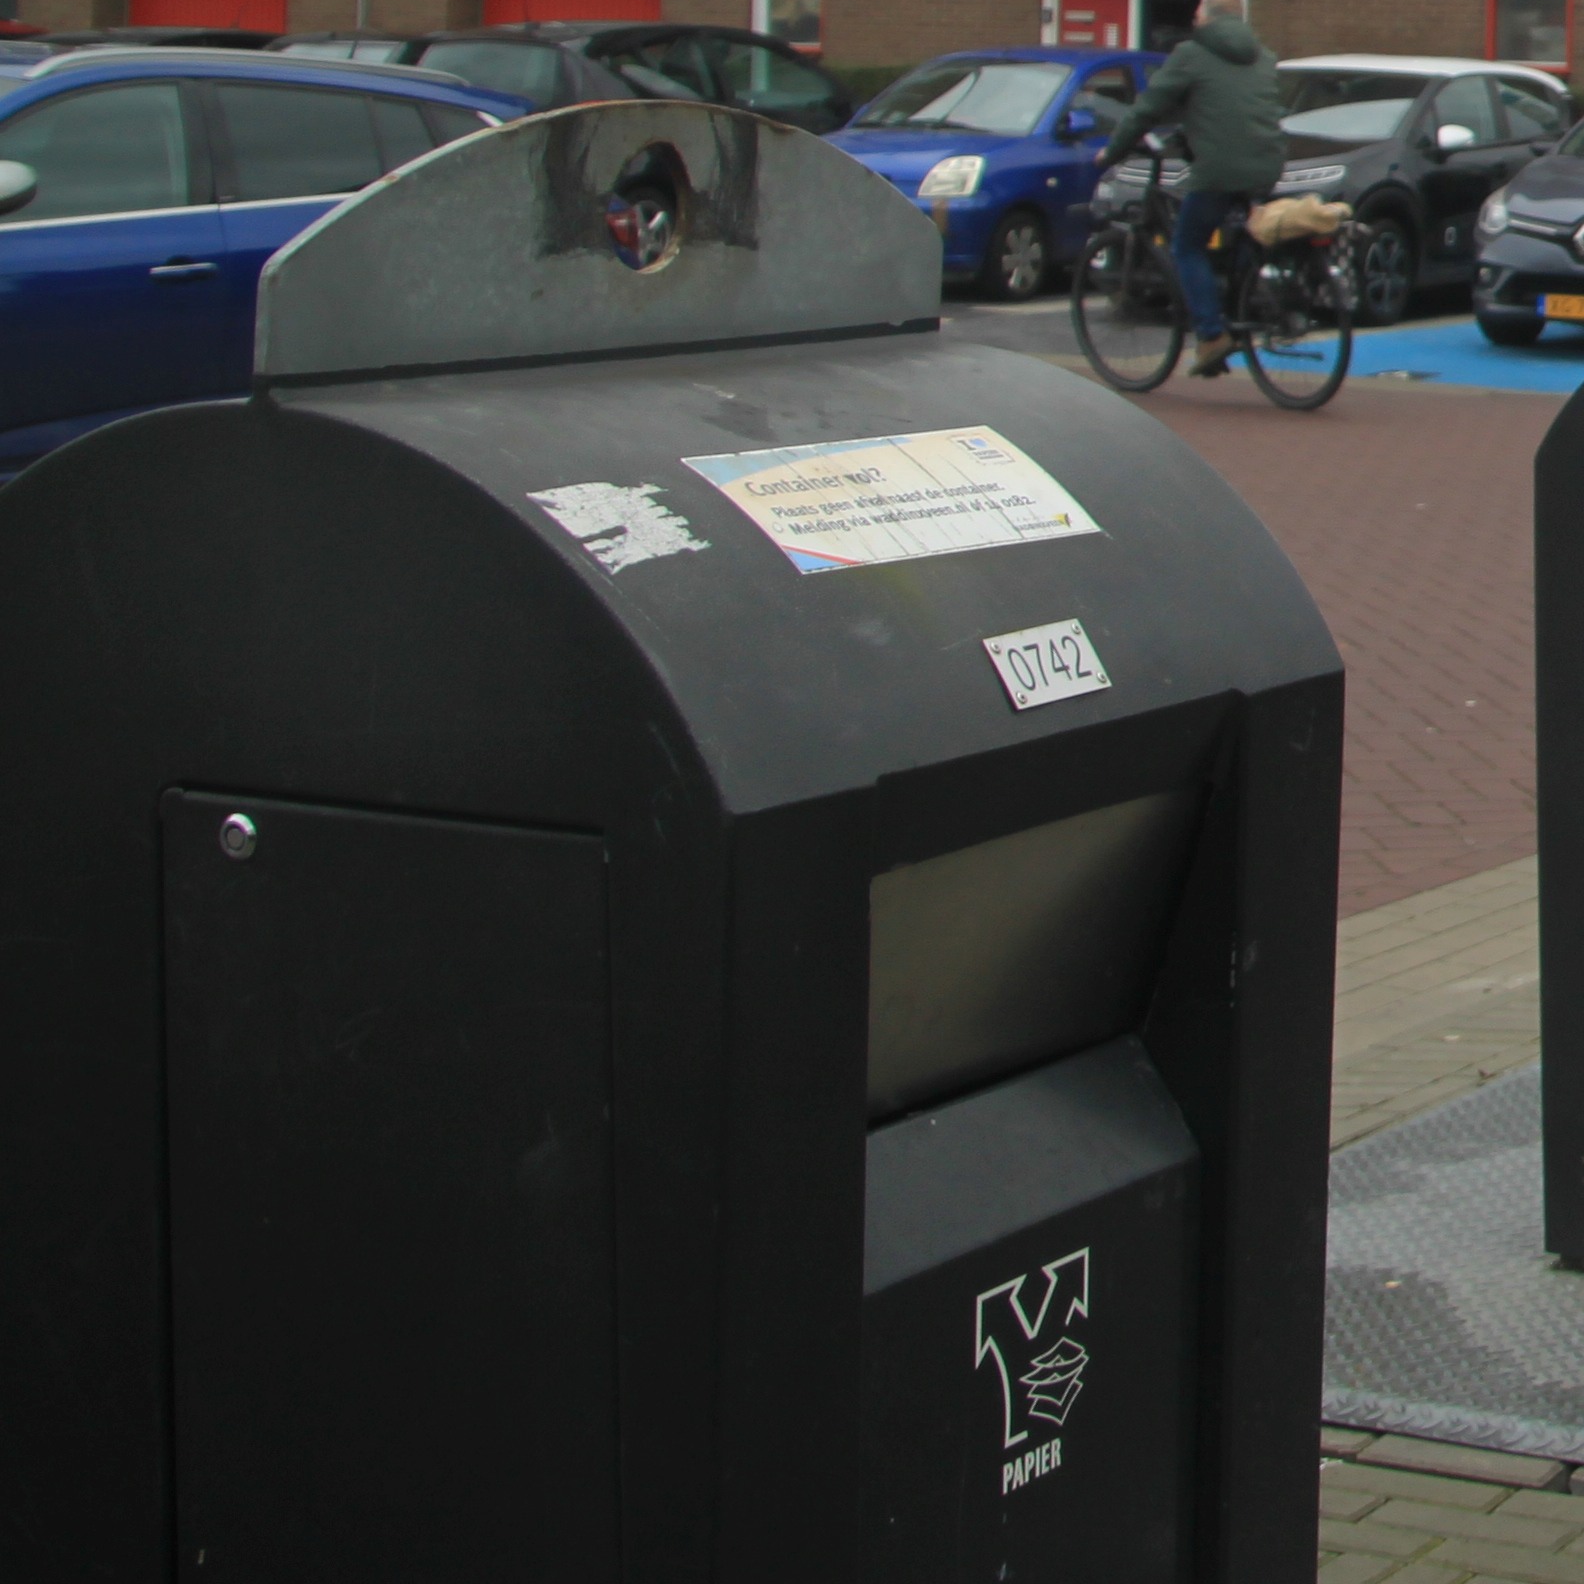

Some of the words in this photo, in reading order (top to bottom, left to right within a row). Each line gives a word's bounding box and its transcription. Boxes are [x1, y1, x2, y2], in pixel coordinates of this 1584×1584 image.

[744, 474, 844, 497] Container
[843, 467, 887, 485] vol?
[771, 504, 819, 518] Plaats
[819, 500, 854, 515] geen
[854, 493, 889, 508] afval
[887, 489, 926, 506] naast
[925, 487, 944, 500] de
[942, 481, 1005, 498] container.
[788, 519, 851, 534] Melding
[849, 514, 872, 527] via
[1007, 635, 1092, 691] 0742
[1002, 1438, 1062, 1495] PAPIER
